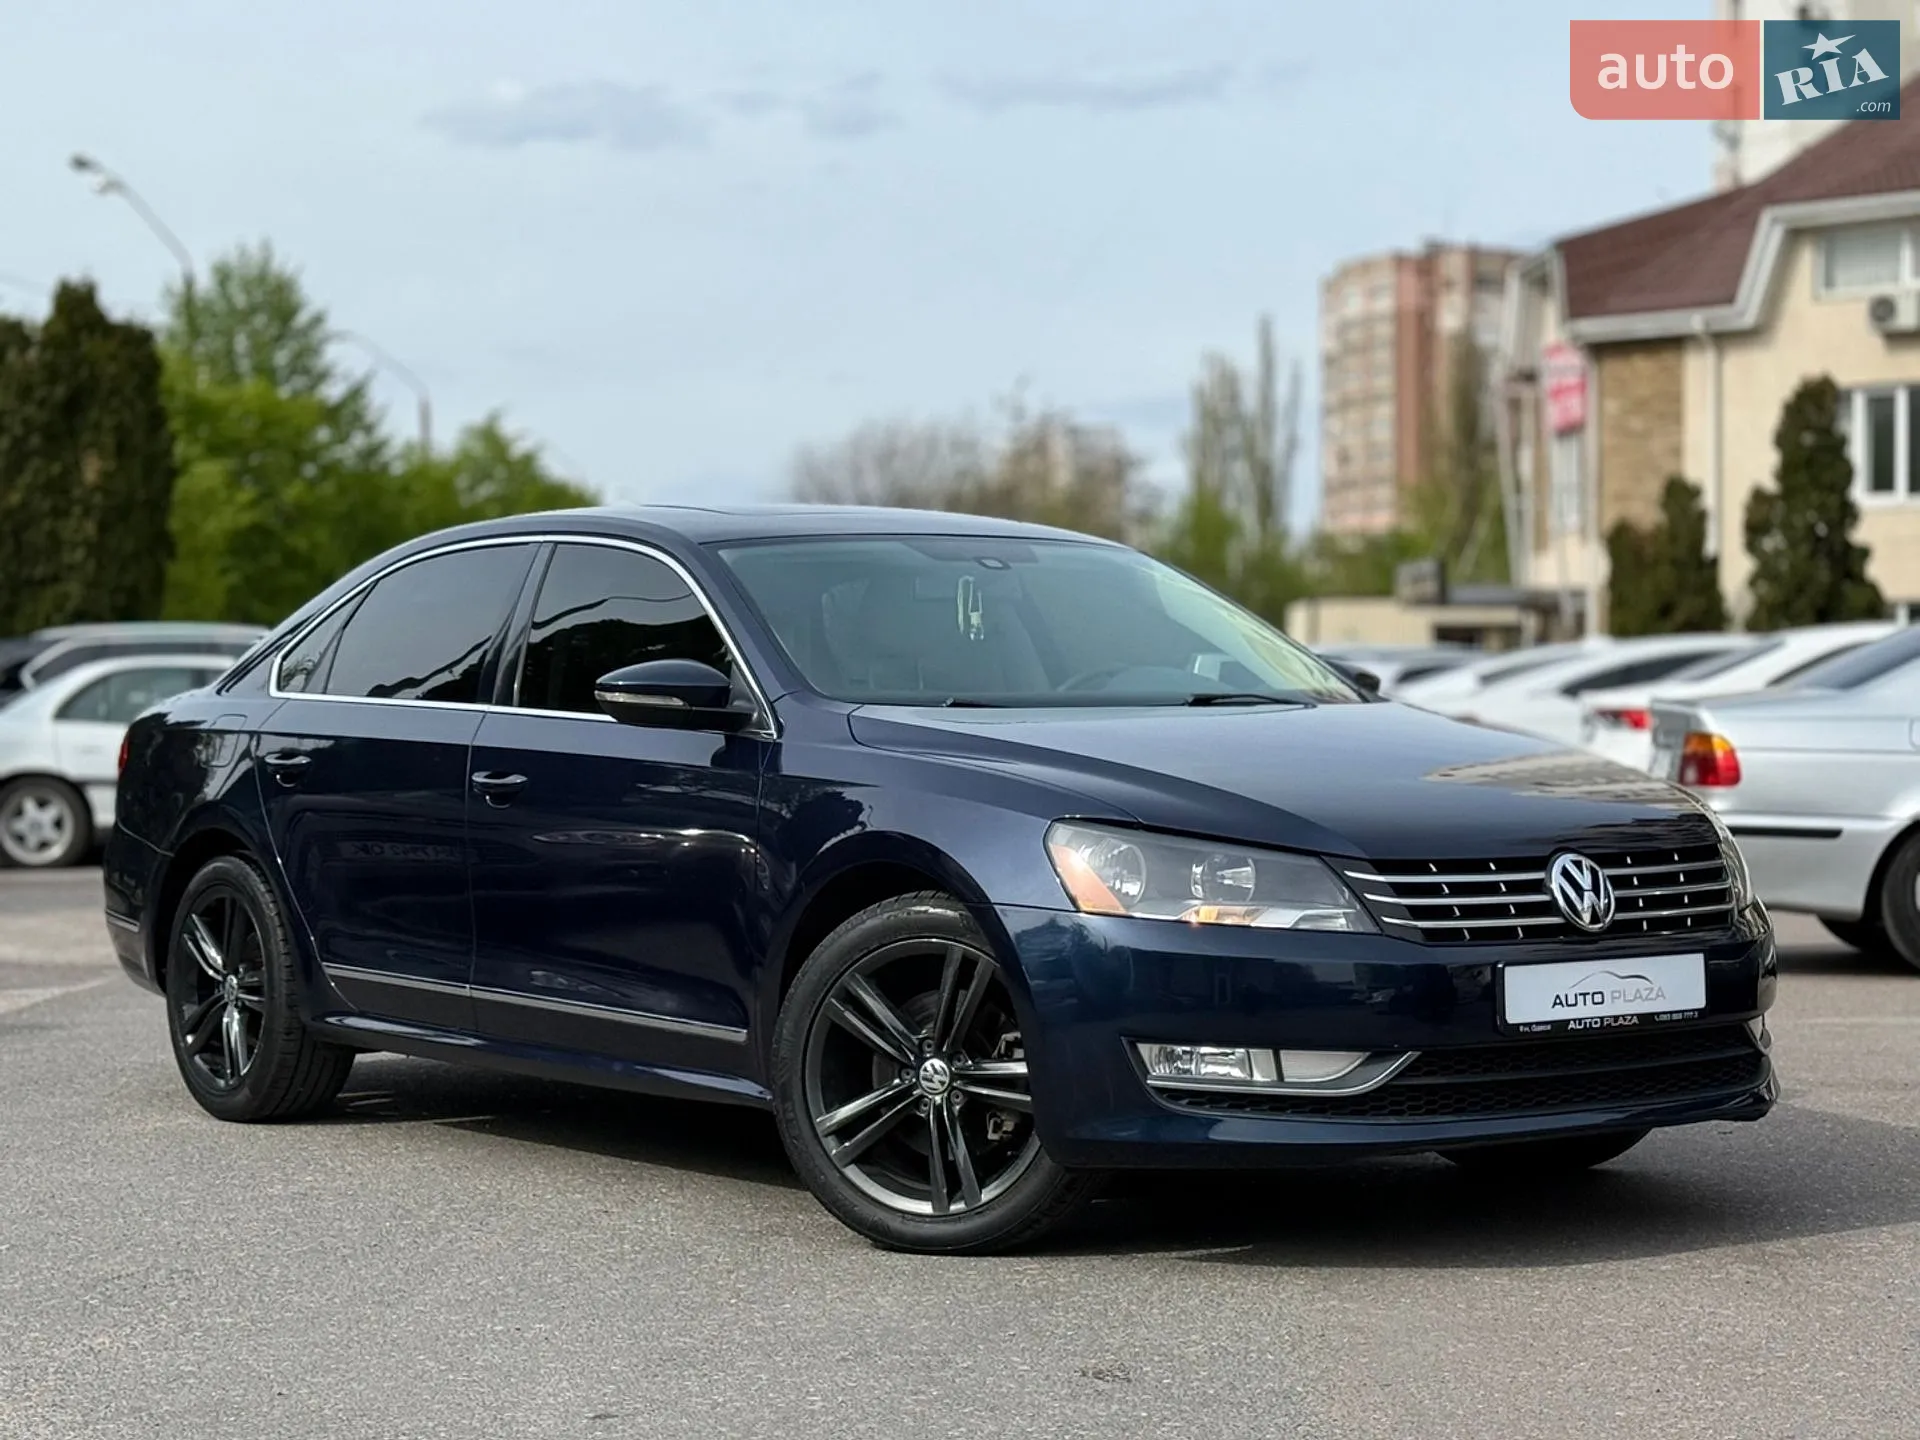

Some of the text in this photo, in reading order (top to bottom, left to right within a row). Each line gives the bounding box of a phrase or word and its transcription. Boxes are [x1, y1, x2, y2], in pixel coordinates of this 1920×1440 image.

[1551, 986, 1666, 1009] AUTO PLAZA
[1567, 1018, 1601, 1031] AUTO
[1603, 1015, 1640, 1027] PLAZA
